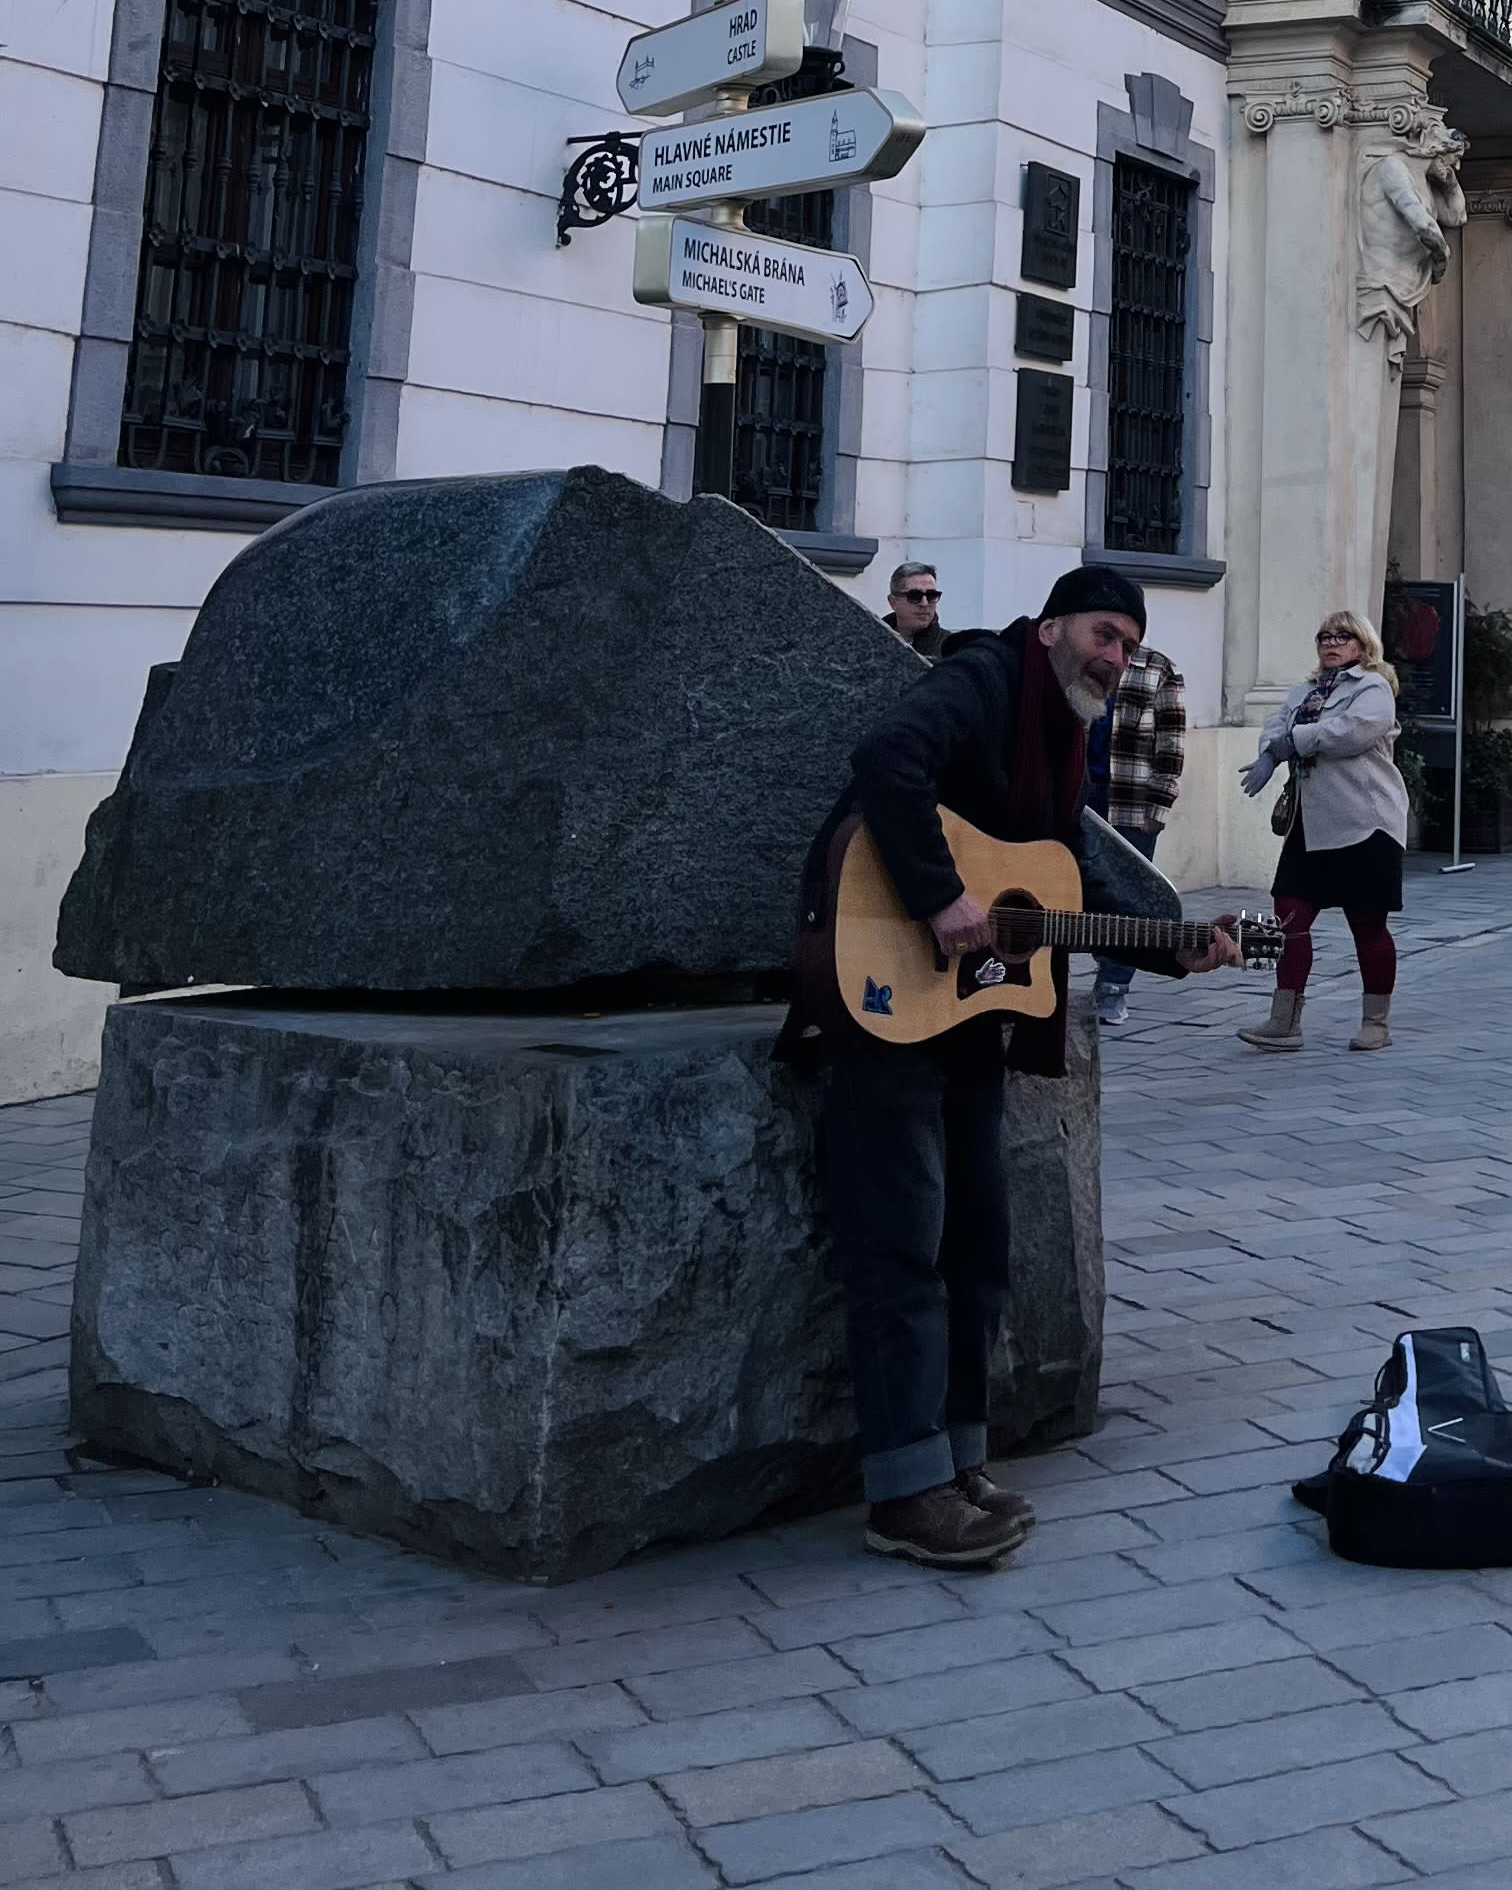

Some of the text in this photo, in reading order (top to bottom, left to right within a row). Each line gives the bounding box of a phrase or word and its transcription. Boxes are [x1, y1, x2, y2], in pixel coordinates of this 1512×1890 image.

[728, 9, 758, 38] HRAD
[727, 40, 757, 64] CASTLE
[654, 121, 791, 166] HLAVNÉ NÁMESTIE
[652, 164, 732, 193] MAIN SQUARE
[684, 237, 805, 286] MICHALSKÁ BRÁNA
[682, 270, 765, 304] MICHAEL'S GATE
